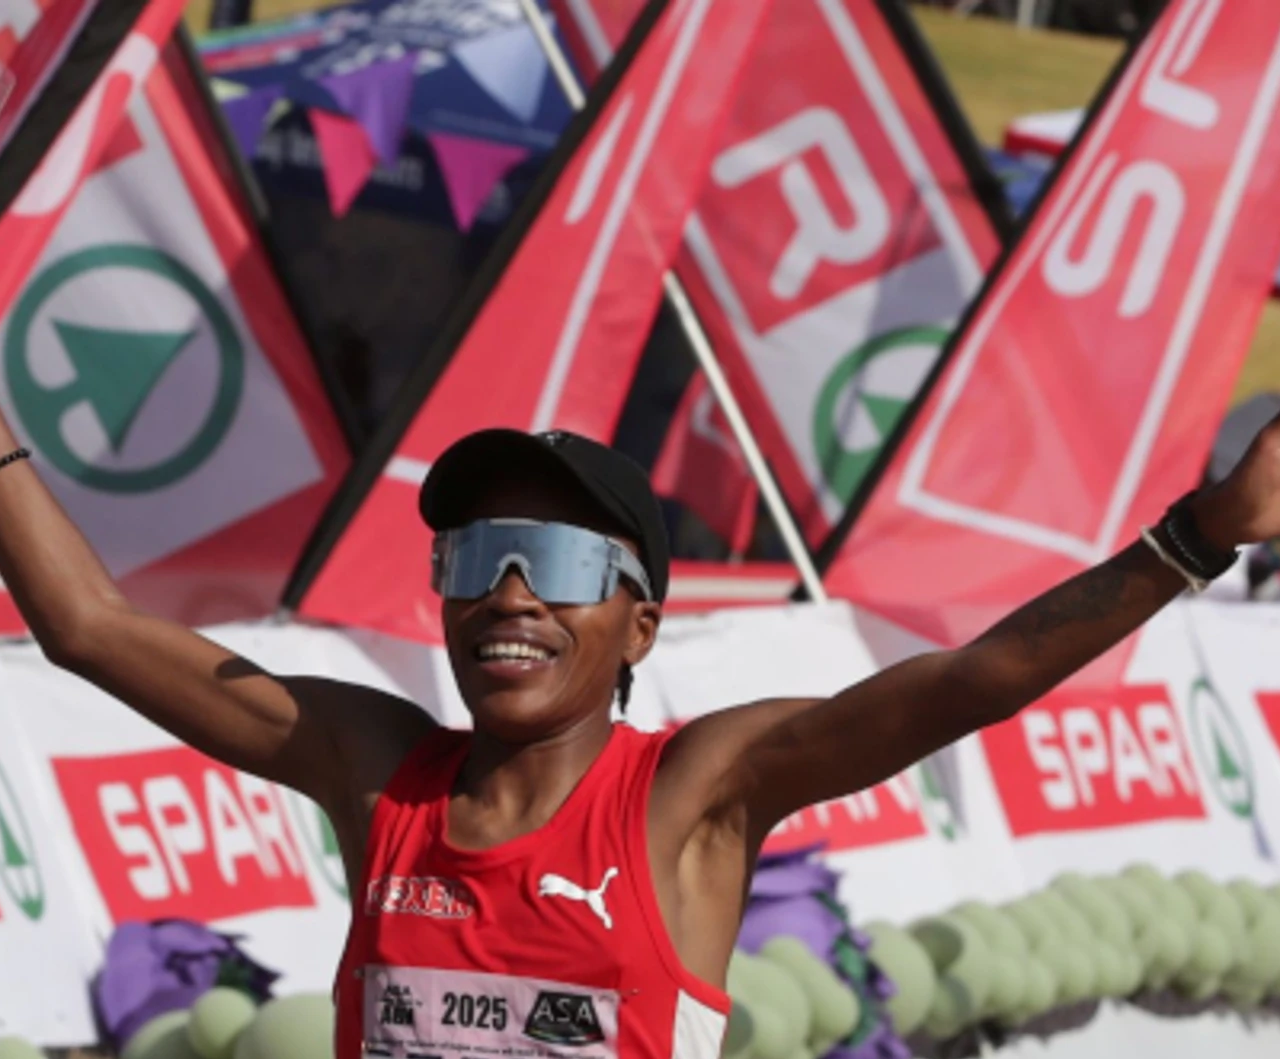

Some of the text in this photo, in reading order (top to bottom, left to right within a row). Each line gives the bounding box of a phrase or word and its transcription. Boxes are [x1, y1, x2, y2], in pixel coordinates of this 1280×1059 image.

[1022, 701, 1197, 811] SPAR
[96, 768, 308, 900] SPAR
[440, 992, 509, 1031] 2025
[535, 999, 595, 1025] ASA
